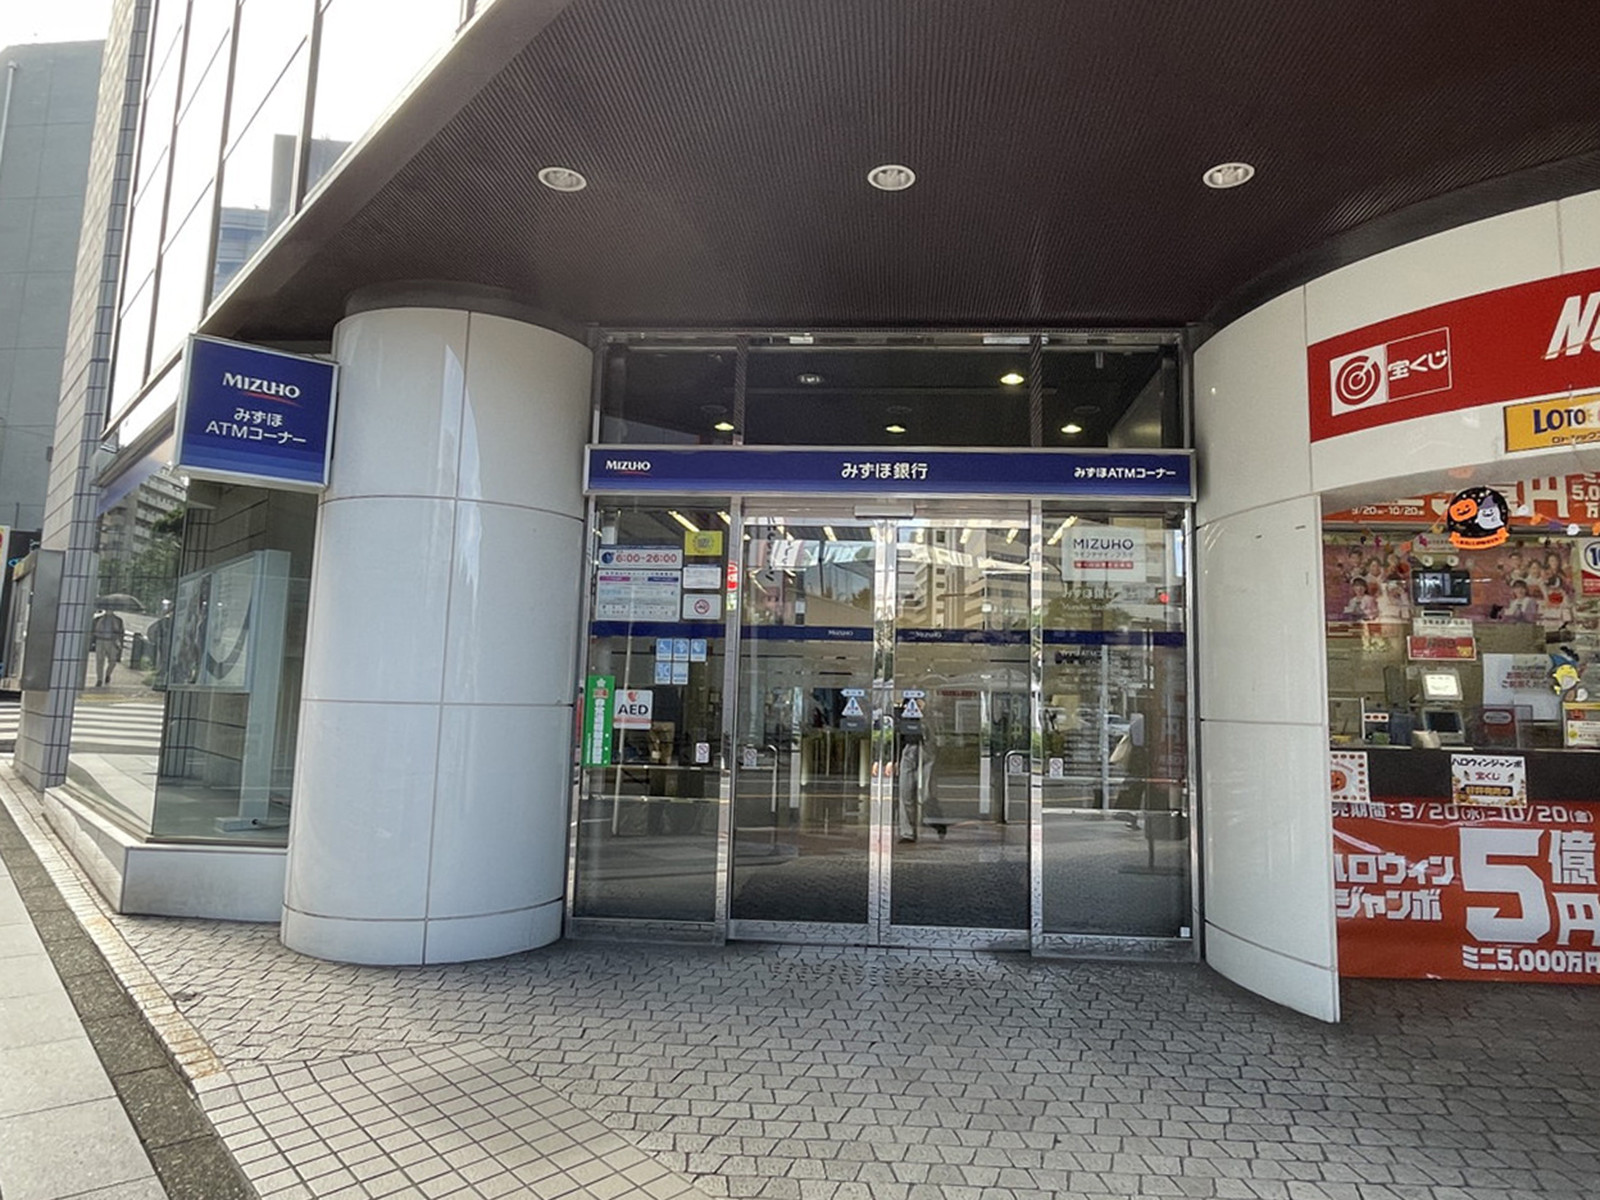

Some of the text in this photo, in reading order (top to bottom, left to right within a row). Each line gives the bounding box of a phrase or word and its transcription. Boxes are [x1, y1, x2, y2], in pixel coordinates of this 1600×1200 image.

[1388, 349, 1448, 380] 宝くじ
[222, 372, 301, 399] MIZUHO
[233, 407, 283, 428] みずほ
[1533, 408, 1586, 435] LOTO
[205, 420, 307, 444] ATMコーナー
[605, 460, 651, 471] MIZUHO
[840, 462, 928, 480] みずほ銀行
[1073, 466, 1176, 479] みずほATMコーナー
[1073, 538, 1134, 550] MIZUHO
[618, 704, 649, 716] AED
[1451, 757, 1522, 769] ハロウィンジャンボ
[1475, 770, 1501, 781] 宝くじ
[1336, 886, 1442, 920] ジャンボ
